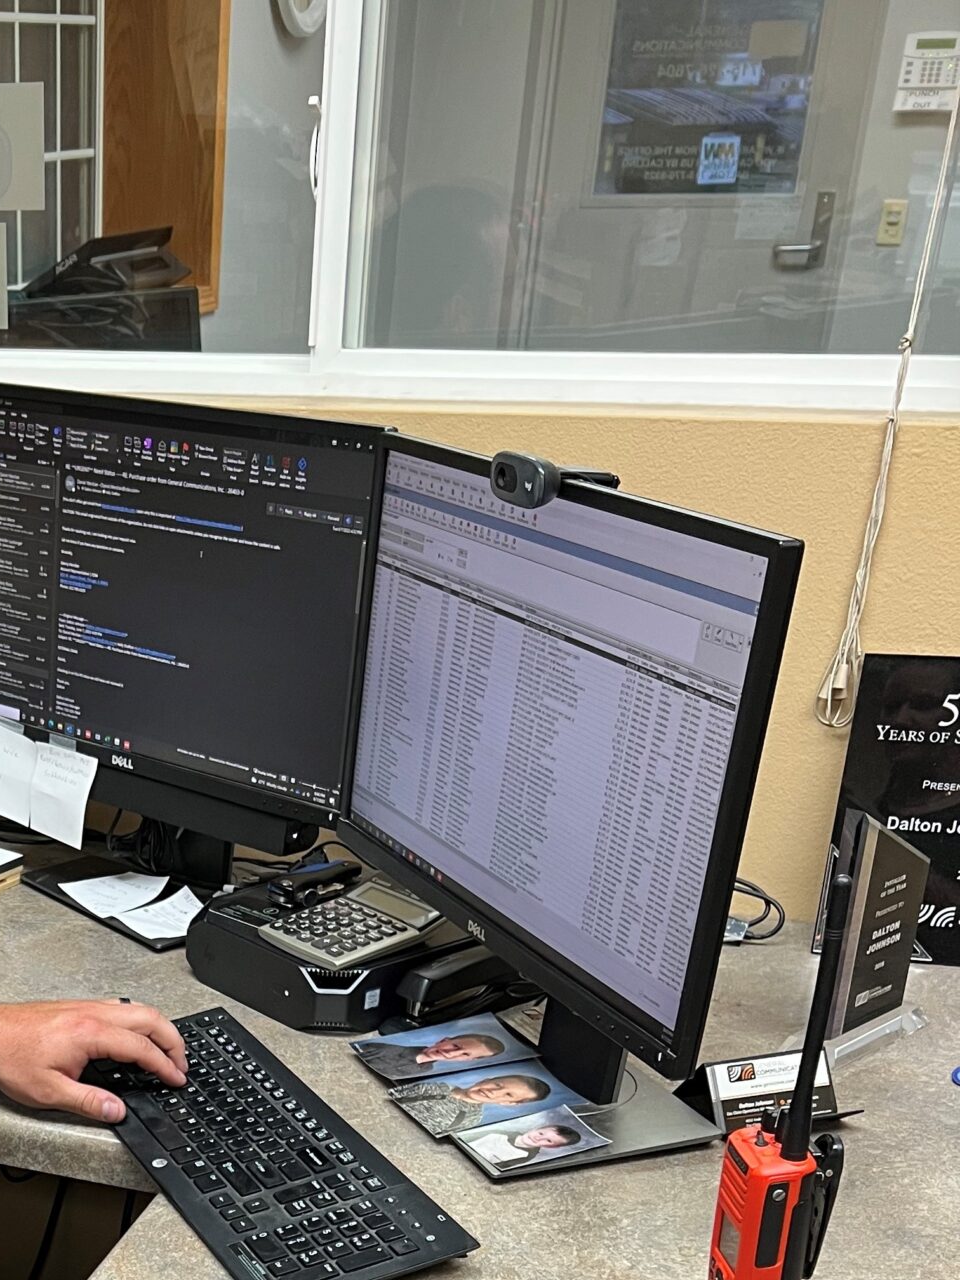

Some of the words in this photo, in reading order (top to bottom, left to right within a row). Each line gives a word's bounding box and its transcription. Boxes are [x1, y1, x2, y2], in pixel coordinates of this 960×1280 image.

[912, 101, 931, 109] OUT
[111, 754, 134, 770] DELL
[887, 815, 942, 833] Dalton
[467, 919, 486, 942] DELL
[872, 920, 901, 940] DALTON
[866, 932, 902, 955] JOHNSON
